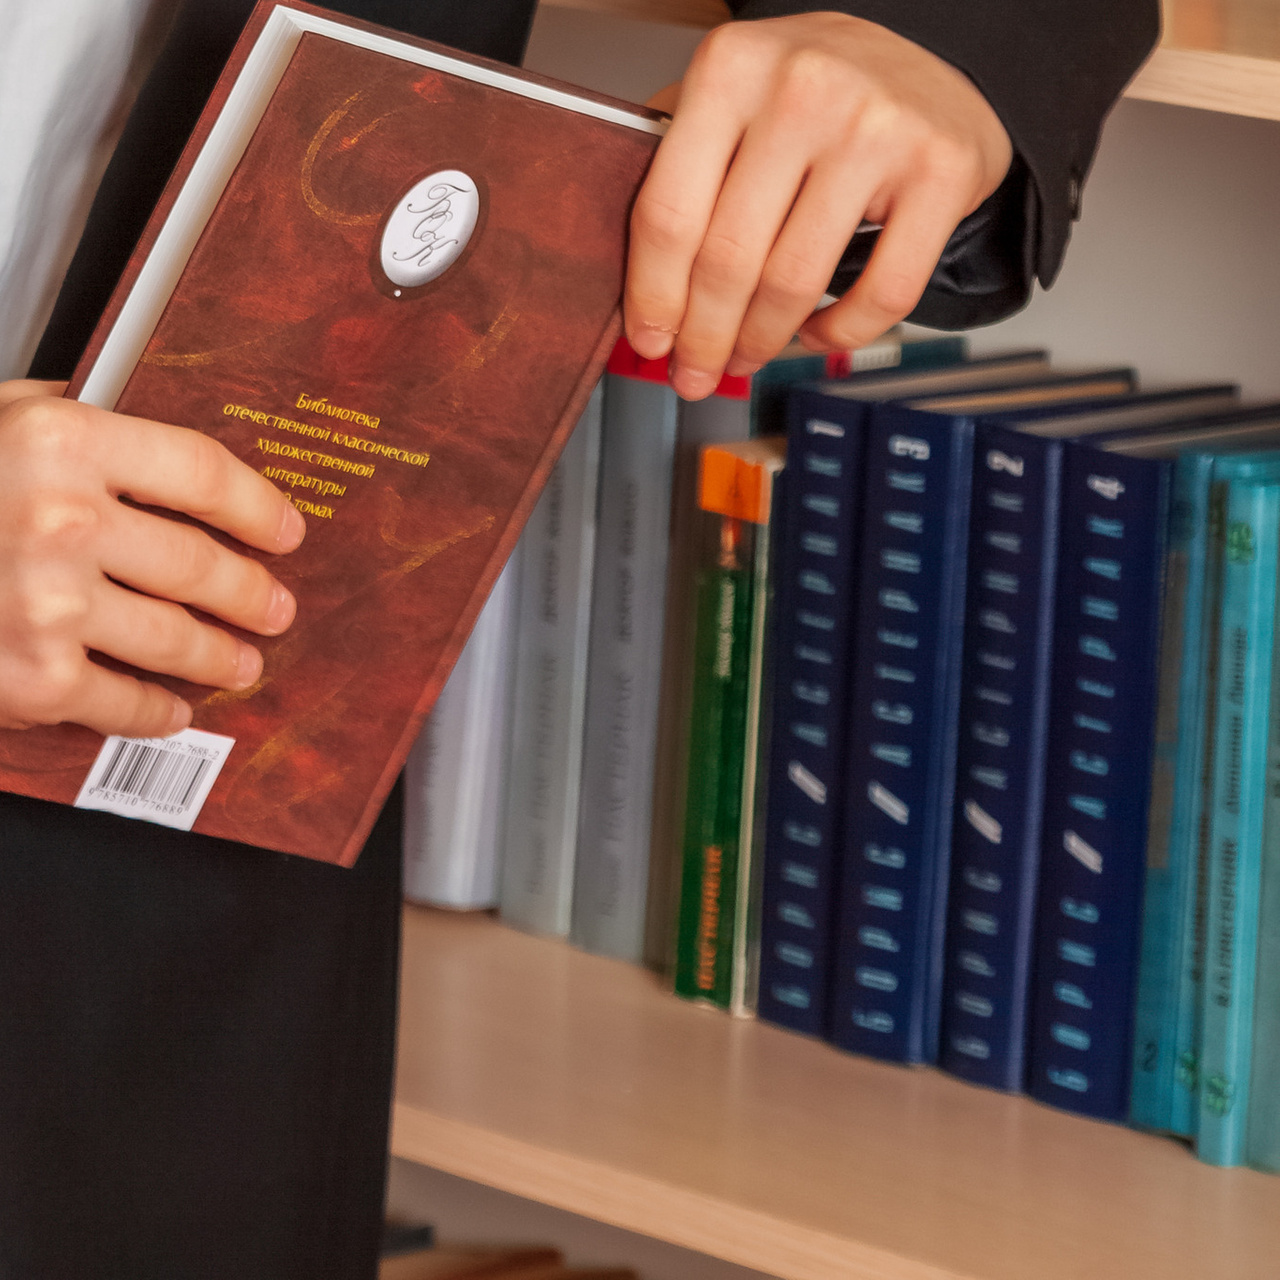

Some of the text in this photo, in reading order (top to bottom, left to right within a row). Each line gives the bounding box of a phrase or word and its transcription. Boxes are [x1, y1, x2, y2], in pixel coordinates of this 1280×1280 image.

[223, 403, 430, 468] отечественной классической
[295, 392, 381, 429] Библиотека
[256, 438, 376, 479] художественной
[261, 466, 347, 497] литературы
[294, 497, 336, 520] томах
[771, 821, 822, 1009] БОРИС
[806, 419, 845, 439] 1
[852, 843, 906, 1033] БОРИС
[887, 434, 931, 460] 3
[952, 866, 1002, 1059] БОРИС
[985, 449, 1024, 477] 2
[1047, 897, 1101, 1093] БОРИС
[1087, 473, 1126, 501] 4
